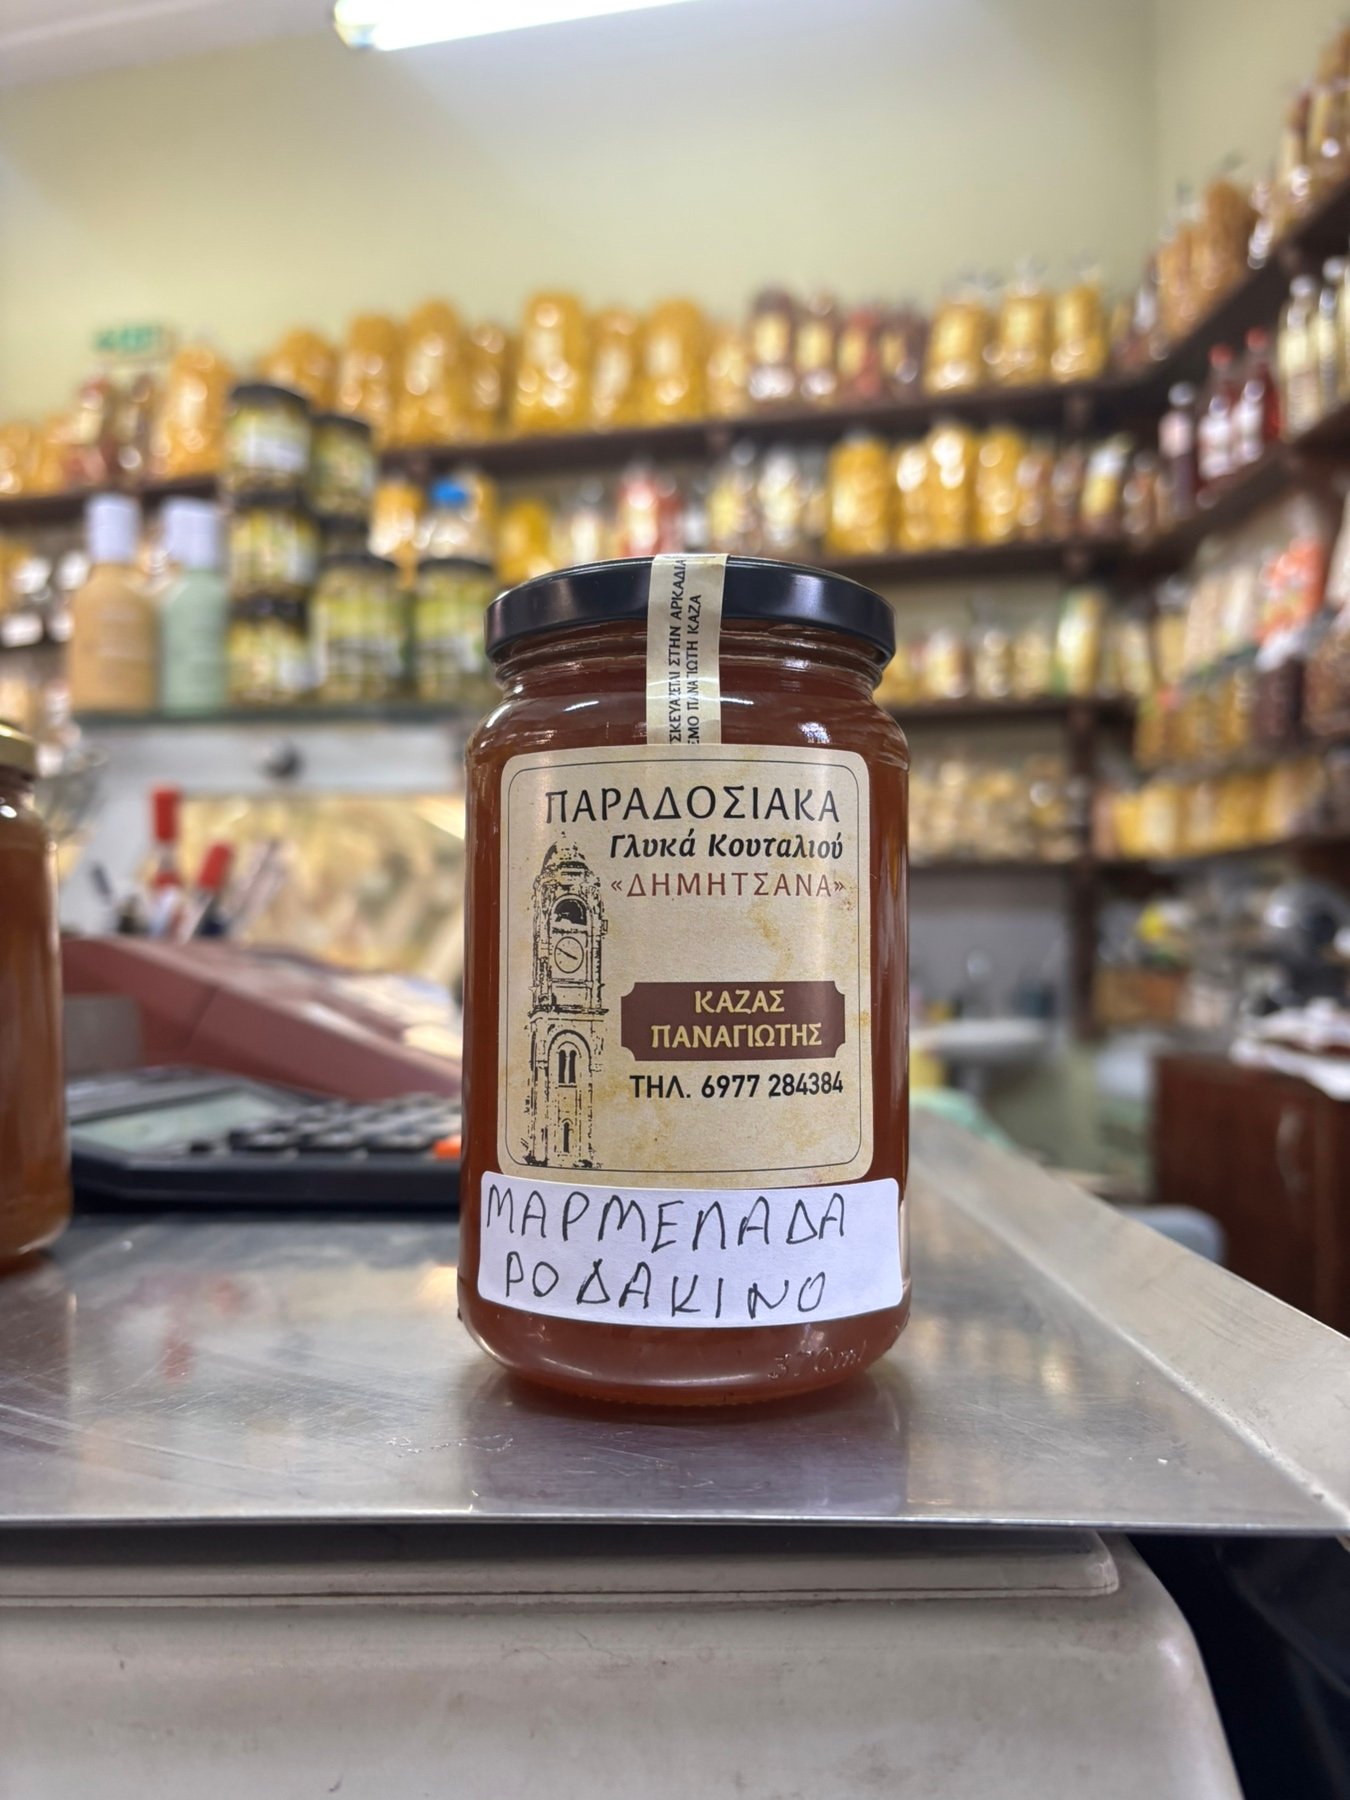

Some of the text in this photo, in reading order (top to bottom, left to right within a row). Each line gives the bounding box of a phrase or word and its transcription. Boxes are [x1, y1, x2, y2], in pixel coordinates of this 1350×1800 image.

[670, 559, 687, 621] ΑΡΚΑΔΙΑ
[687, 594, 701, 635] ΚΑΖΑ
[668, 626, 681, 667] ΣΤΗΝ
[545, 785, 840, 824] ΠΑΡΑΔΟΣΙΑΚΑ
[609, 828, 843, 860] Γλυκά Κουταλιού
[609, 871, 846, 898] «ΔΗΜΗΤΣΑΝΑ»
[694, 989, 785, 1015] ΚΑΖΑΣ
[650, 1023, 822, 1049] ΠΑΝΑΓΙΩΤΗΣ
[629, 1071, 844, 1099] ΤΗΛ. 6977 284384
[505, 1251, 826, 1319] ΡΟΔΑΚΙΝΟ
